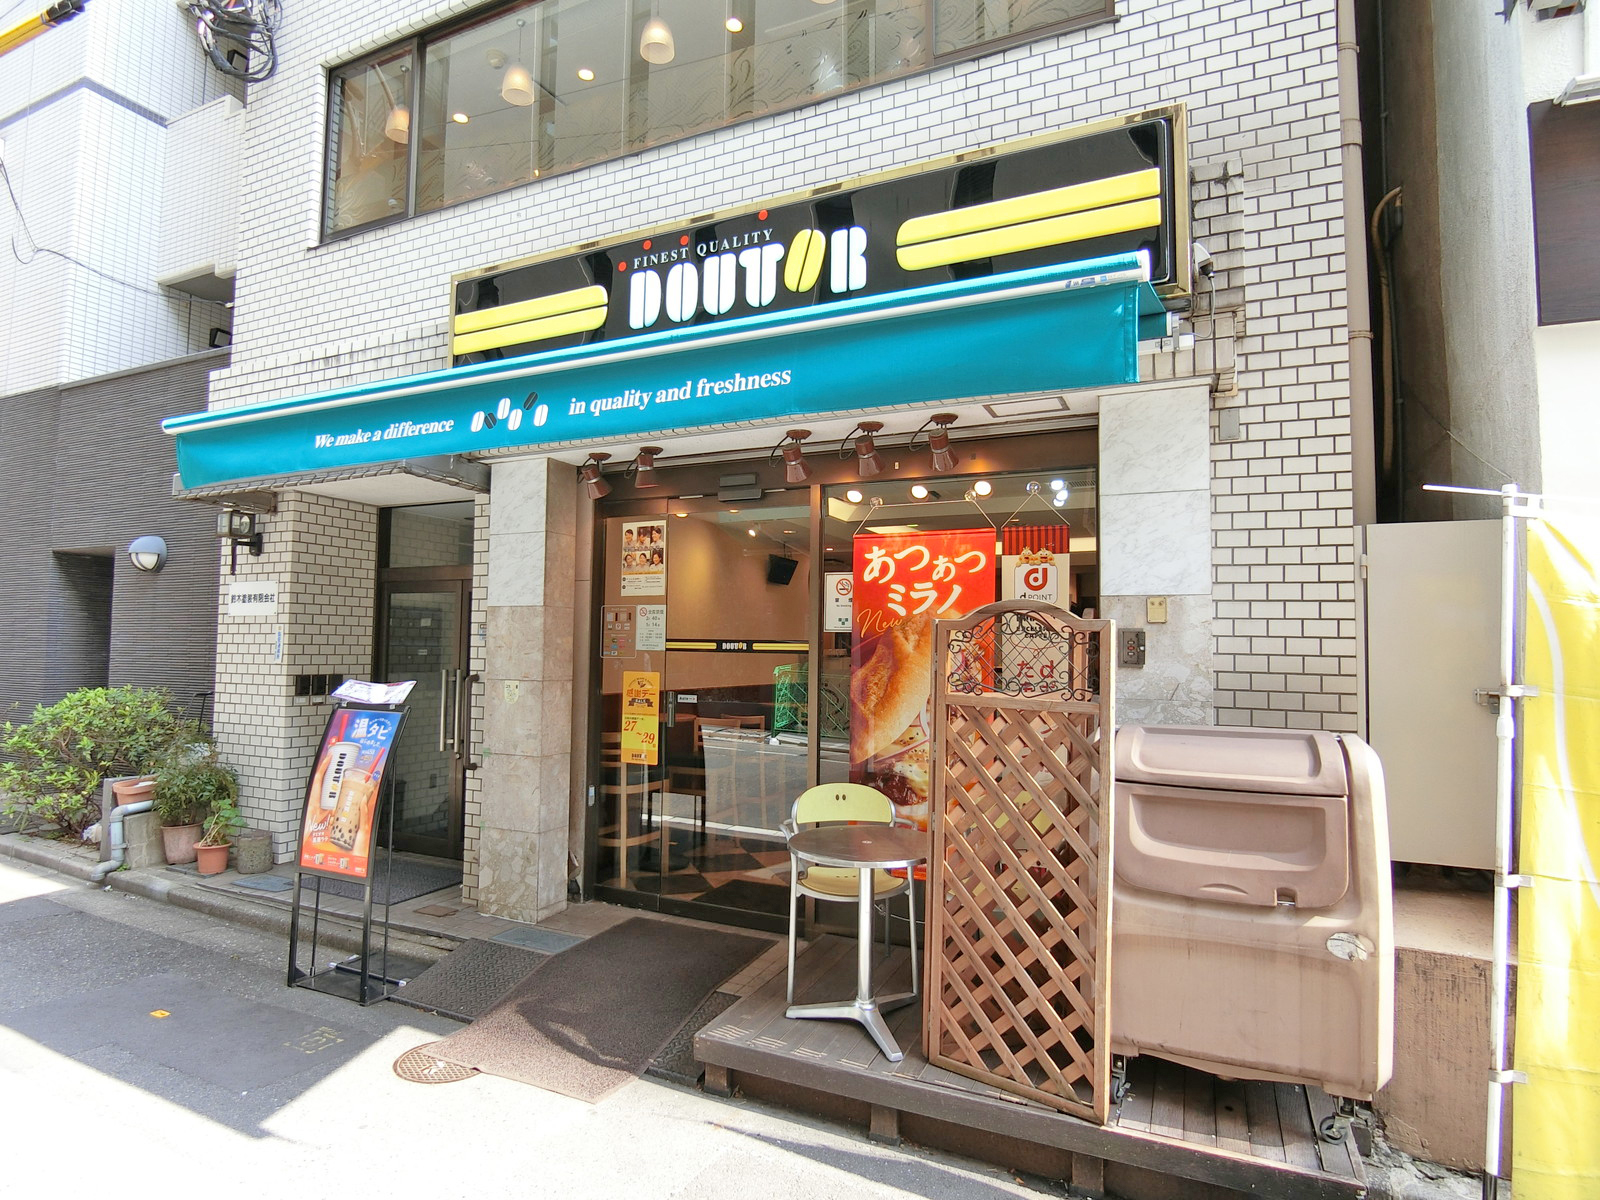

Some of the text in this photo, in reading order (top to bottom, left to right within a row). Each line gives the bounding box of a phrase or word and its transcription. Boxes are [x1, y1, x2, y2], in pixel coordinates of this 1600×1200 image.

[633, 228, 774, 269] FINEST QUALITY
[629, 225, 868, 330] DOUTOR
[568, 369, 792, 417] in quality and freshness
[315, 418, 455, 449] We make a difference
[863, 545, 987, 584] あつあつ
[887, 582, 962, 617] ミラノ
[857, 608, 902, 639] New
[722, 642, 747, 650] DOUTOR
[623, 720, 638, 732] 27
[329, 753, 347, 799] DOUTOR
[307, 814, 331, 832] New!
